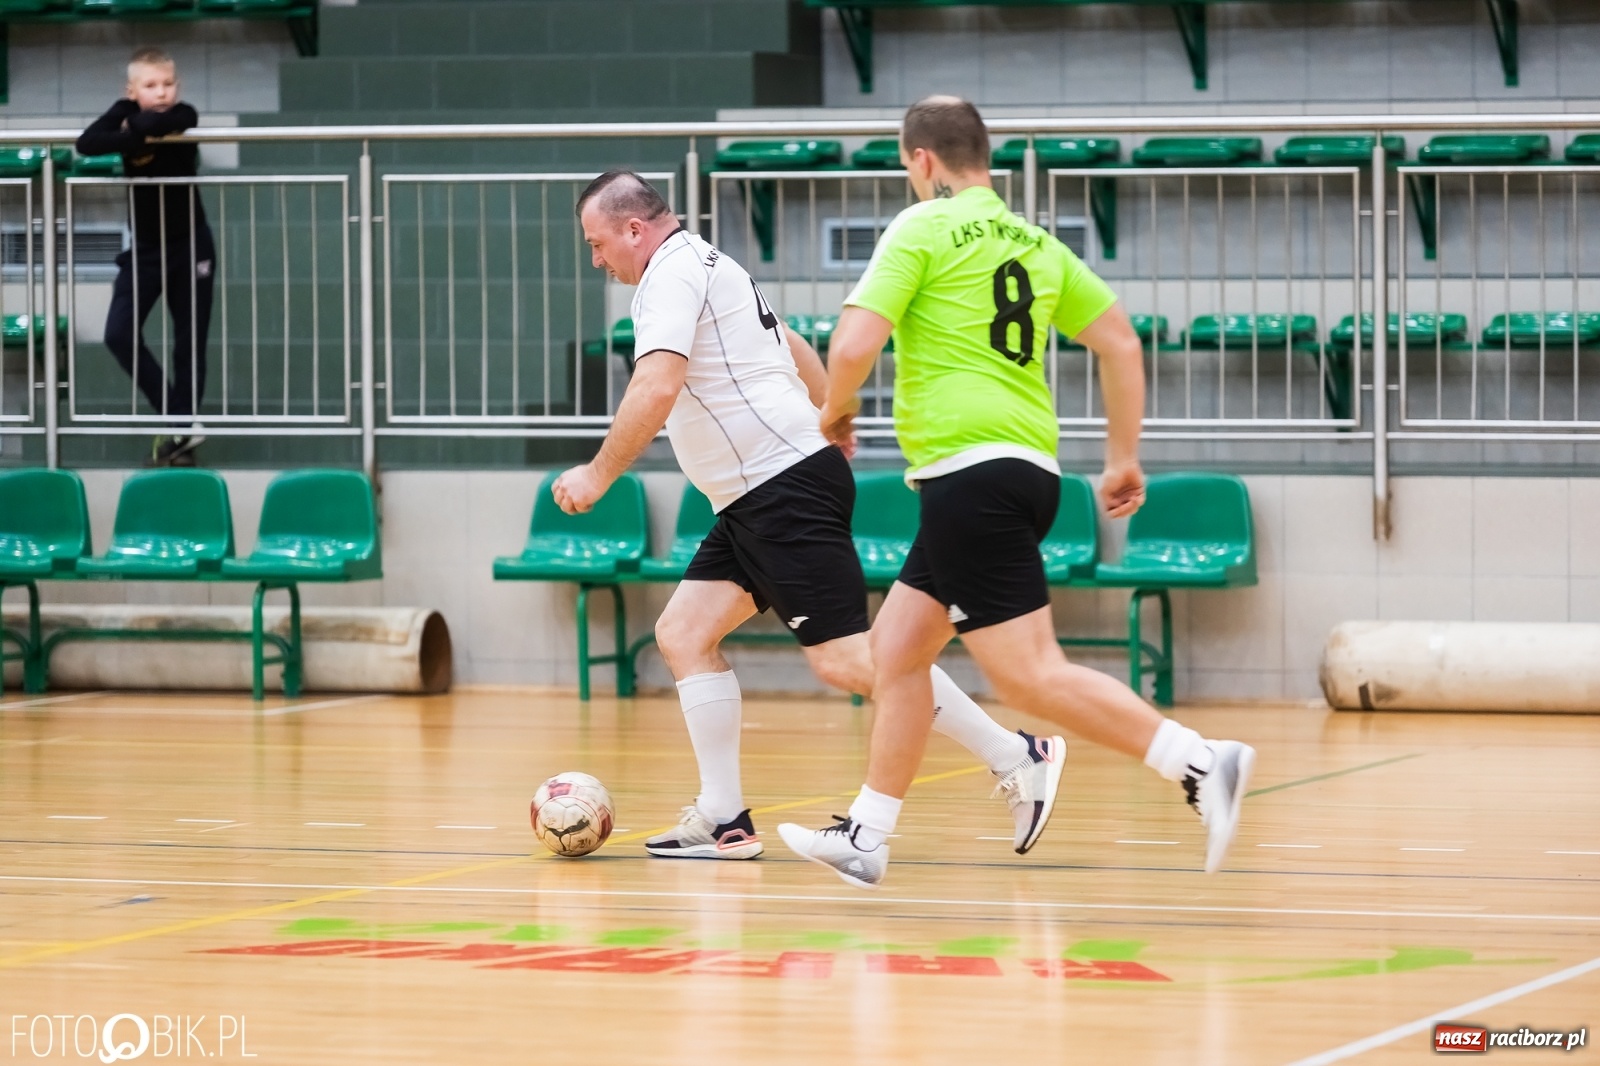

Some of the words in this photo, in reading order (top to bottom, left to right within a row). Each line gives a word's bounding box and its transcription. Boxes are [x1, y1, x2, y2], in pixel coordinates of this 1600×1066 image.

[951, 219, 984, 248] LKS
[749, 276, 781, 346] 4
[991, 257, 1035, 368] 8
